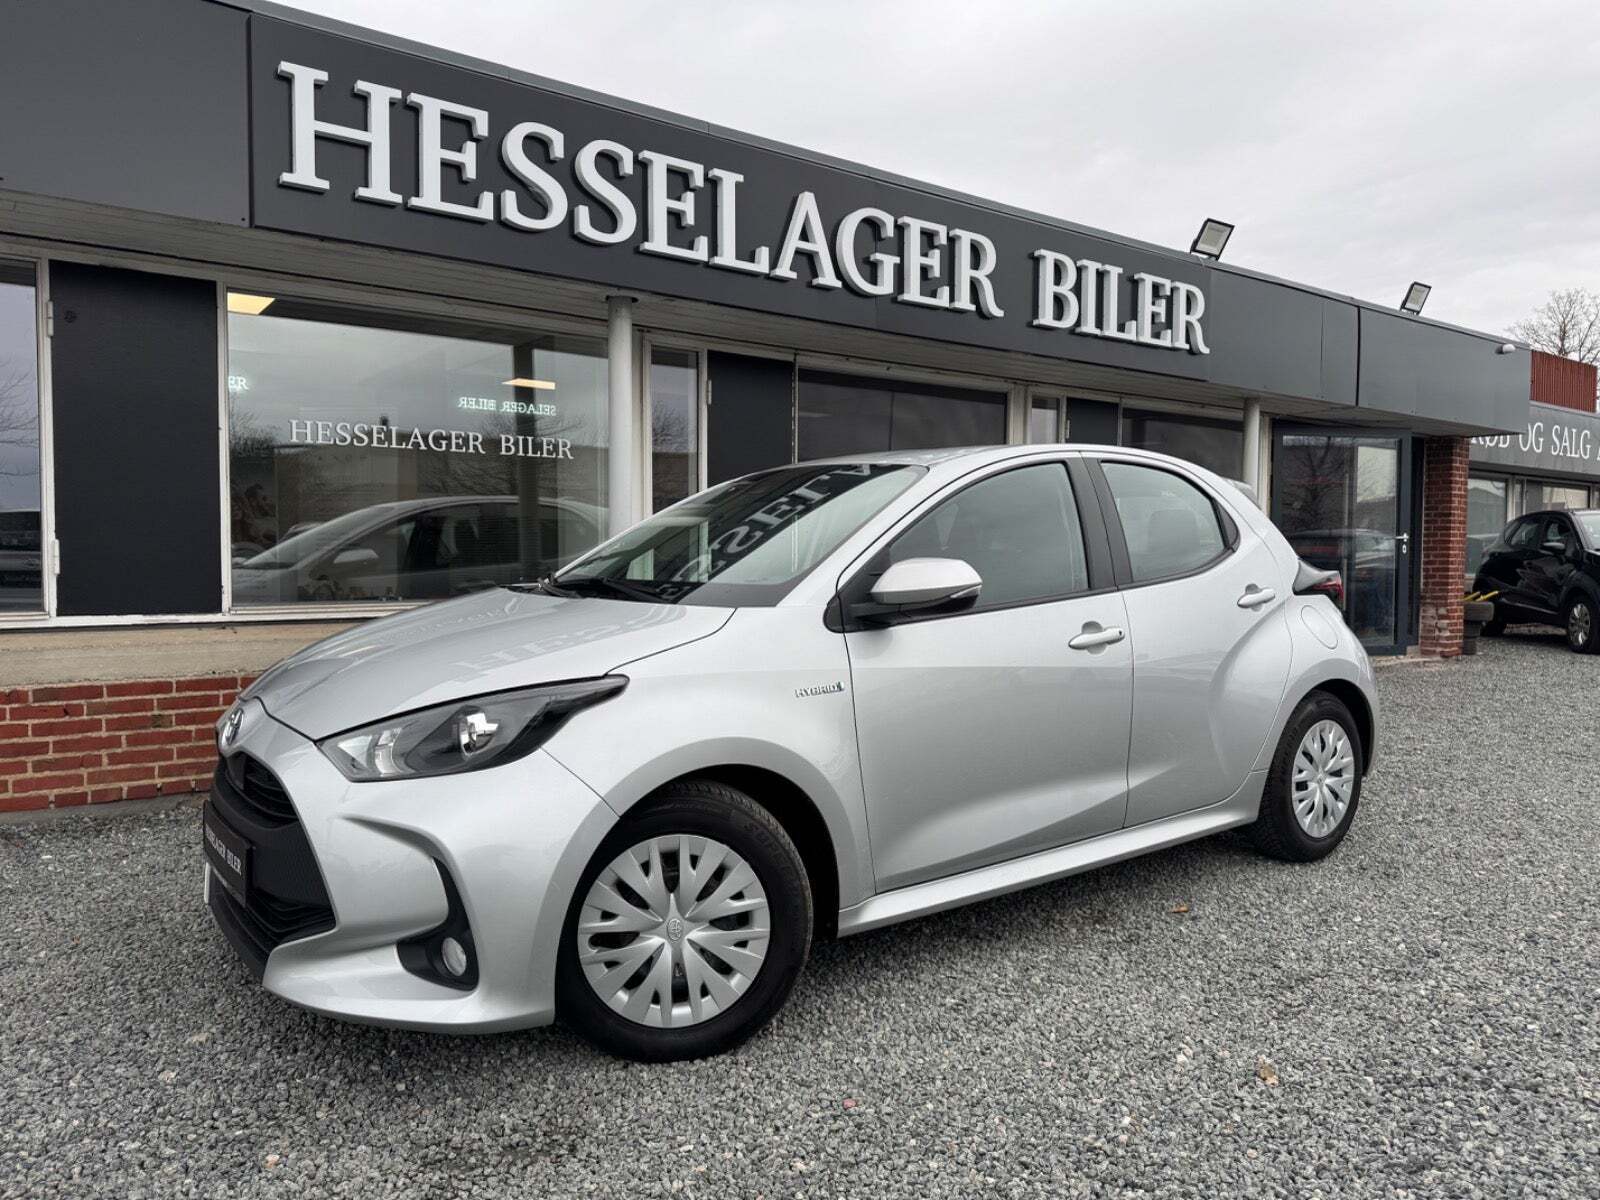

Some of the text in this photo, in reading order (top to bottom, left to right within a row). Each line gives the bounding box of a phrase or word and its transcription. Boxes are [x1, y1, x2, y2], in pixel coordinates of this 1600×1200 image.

[277, 60, 1210, 355] HESSELAGER BILER
[288, 419, 574, 460] HESSELAGER BILER
[1551, 424, 1592, 460] SALG
